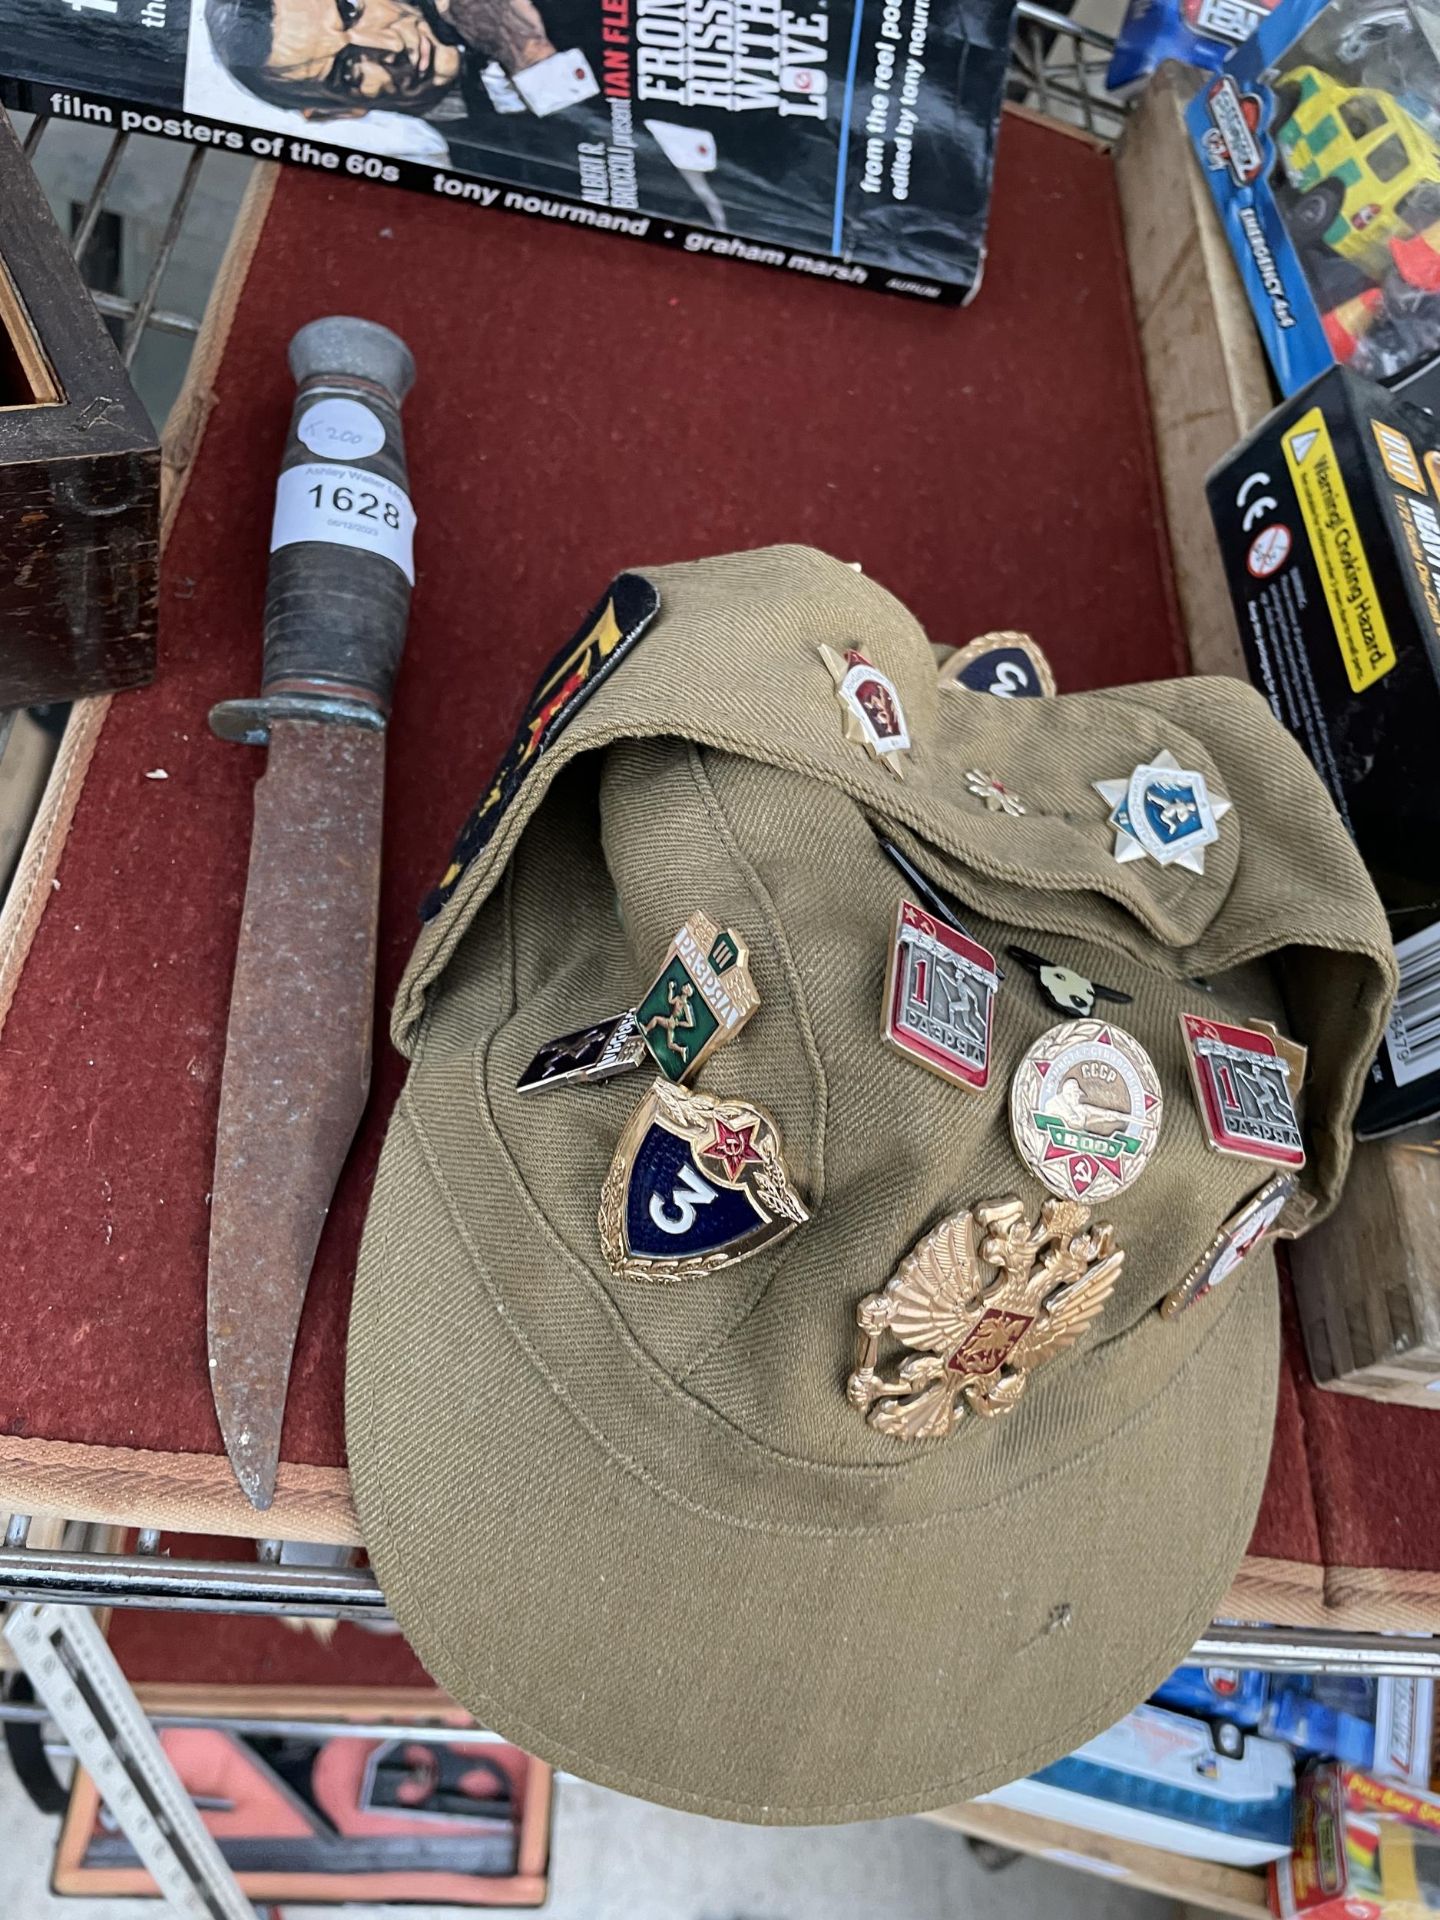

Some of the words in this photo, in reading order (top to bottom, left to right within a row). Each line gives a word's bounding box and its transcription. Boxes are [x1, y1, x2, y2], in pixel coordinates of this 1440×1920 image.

[603, 48, 631, 98] IAN
[900, 58, 925, 106] tony
[50, 92, 112, 123] film
[121, 110, 244, 149] posters
[250, 137, 285, 158] of
[289, 142, 340, 169] the
[345, 153, 400, 182] 60s
[866, 94, 889, 133] the
[895, 108, 919, 135] by
[577, 153, 610, 206] ALBERT
[606, 145, 639, 210] BROCCOLI
[860, 137, 885, 193] from
[890, 136, 912, 200] edited
[433, 173, 501, 206] tony
[504, 191, 650, 236] nourmand
[683, 232, 786, 266] graham
[787, 255, 868, 284] marsh
[308, 484, 401, 531] 1628
[1236, 472, 1278, 532] CE
[1313, 454, 1345, 530] Warning!
[1335, 527, 1365, 601] Choking
[1355, 599, 1387, 669] Hazard.
[910, 958, 930, 1011] 1
[906, 1010, 986, 1066] РАЗРЯД
[1081, 1062, 1118, 1083] СССР
[1217, 1065, 1242, 1113] 1
[1227, 1118, 1302, 1148] РАЗРЯД
